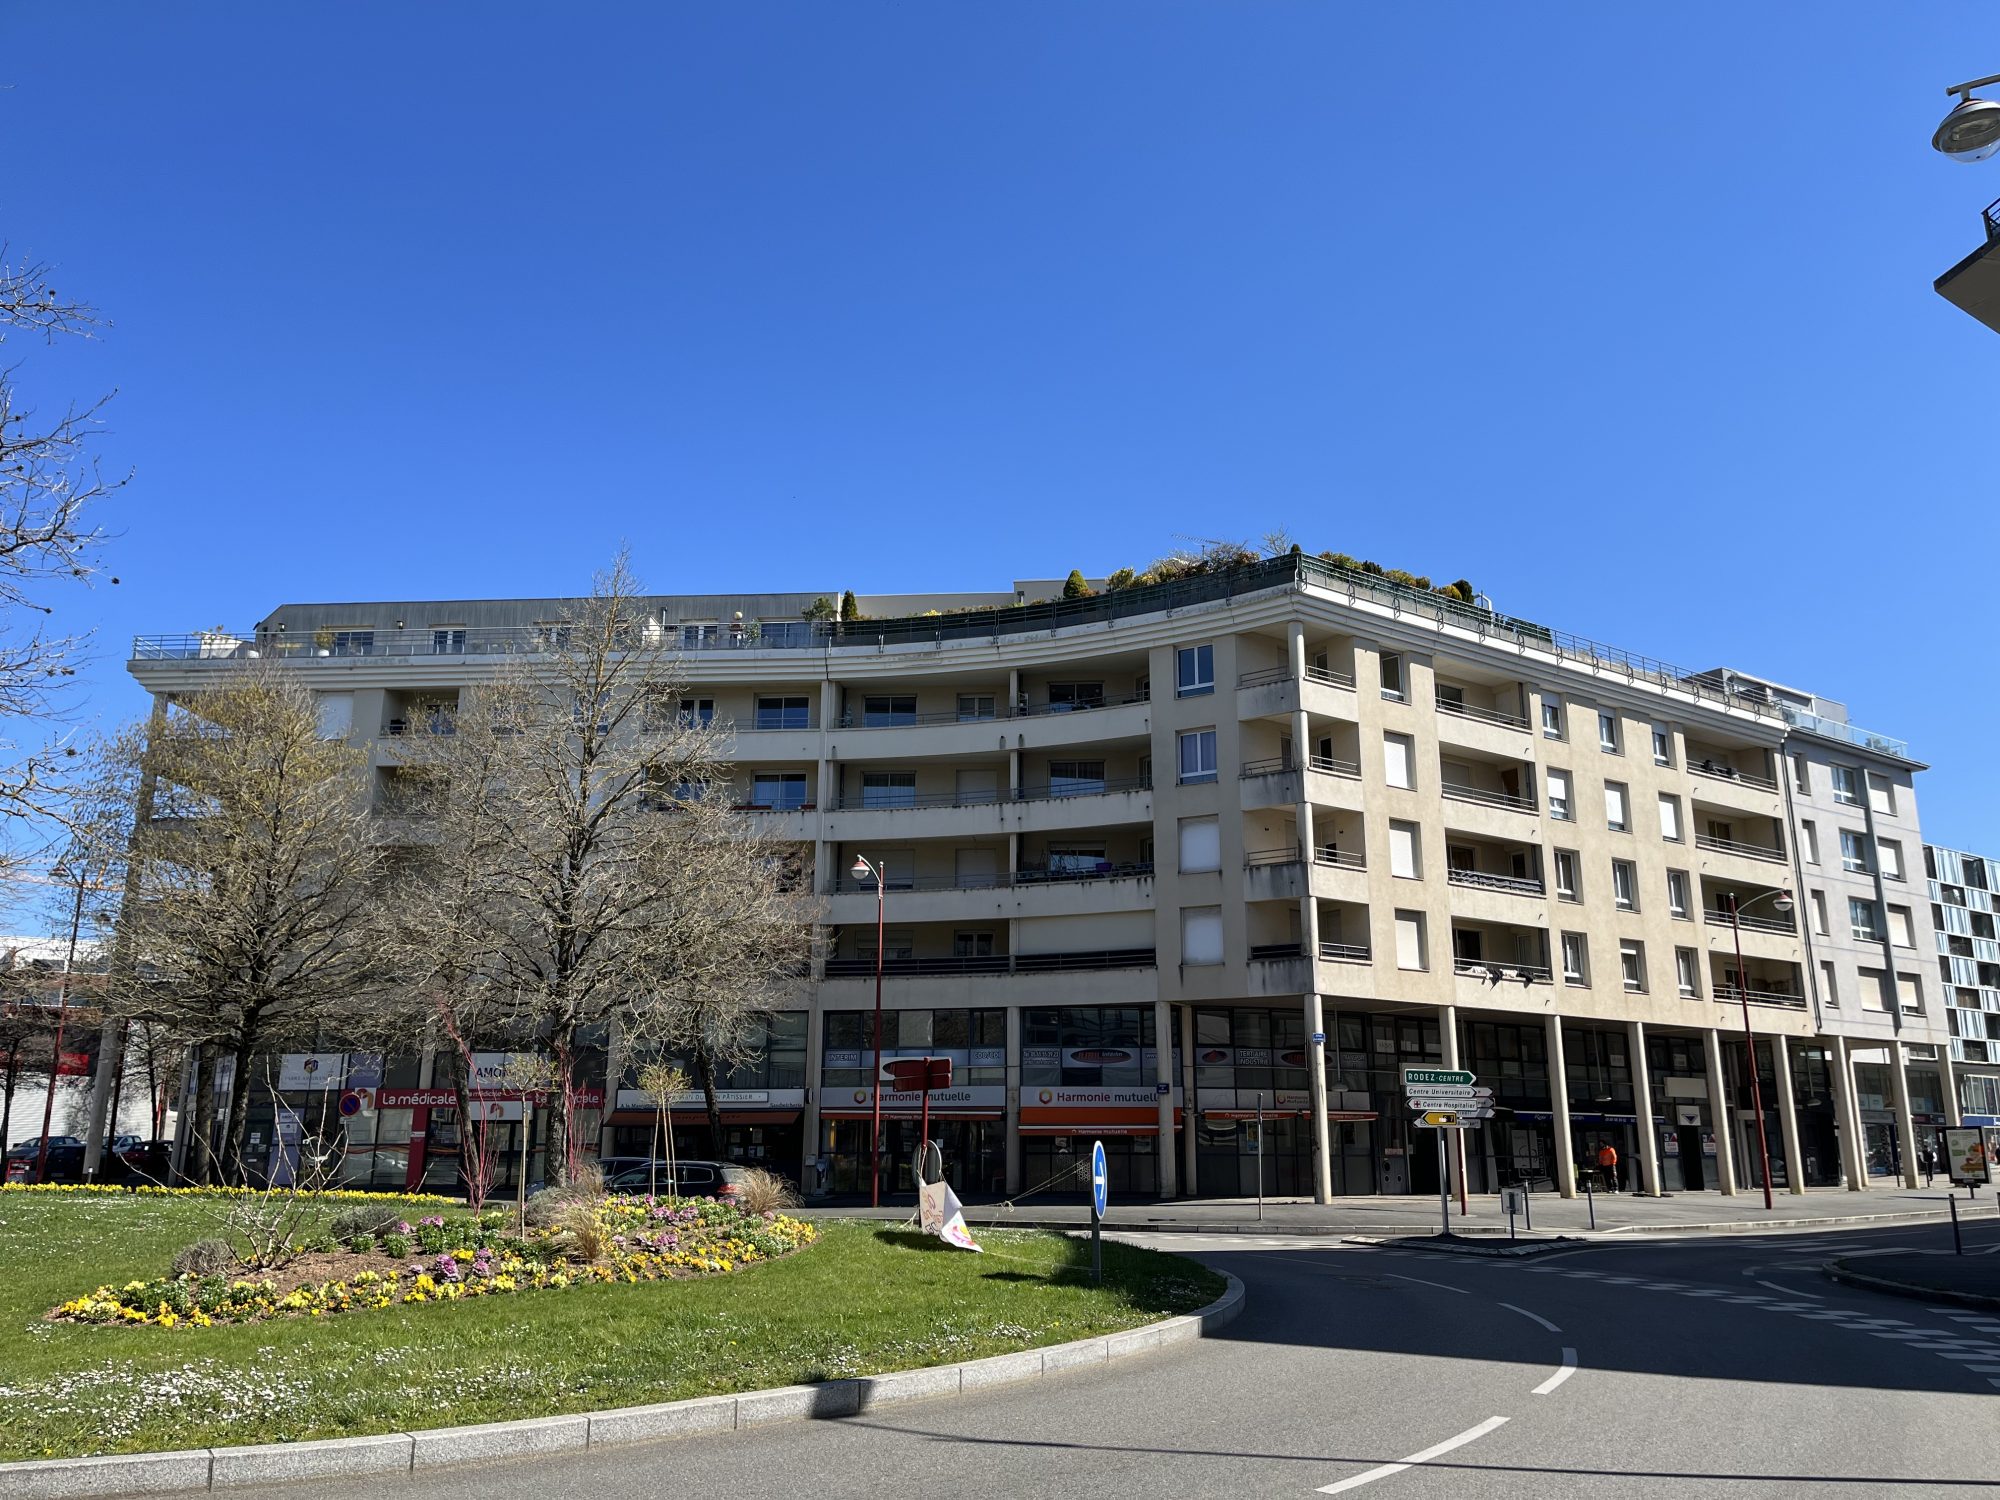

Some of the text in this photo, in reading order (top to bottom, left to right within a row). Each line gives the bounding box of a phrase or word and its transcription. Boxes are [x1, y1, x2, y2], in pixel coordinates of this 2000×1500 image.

[382, 1092, 457, 1105] La médicale
[722, 1092, 753, 1100] PÂTISSIER
[1057, 1092, 1158, 1102] Harmonie mutuell
[1443, 1102, 1476, 1110] Hospitalier
